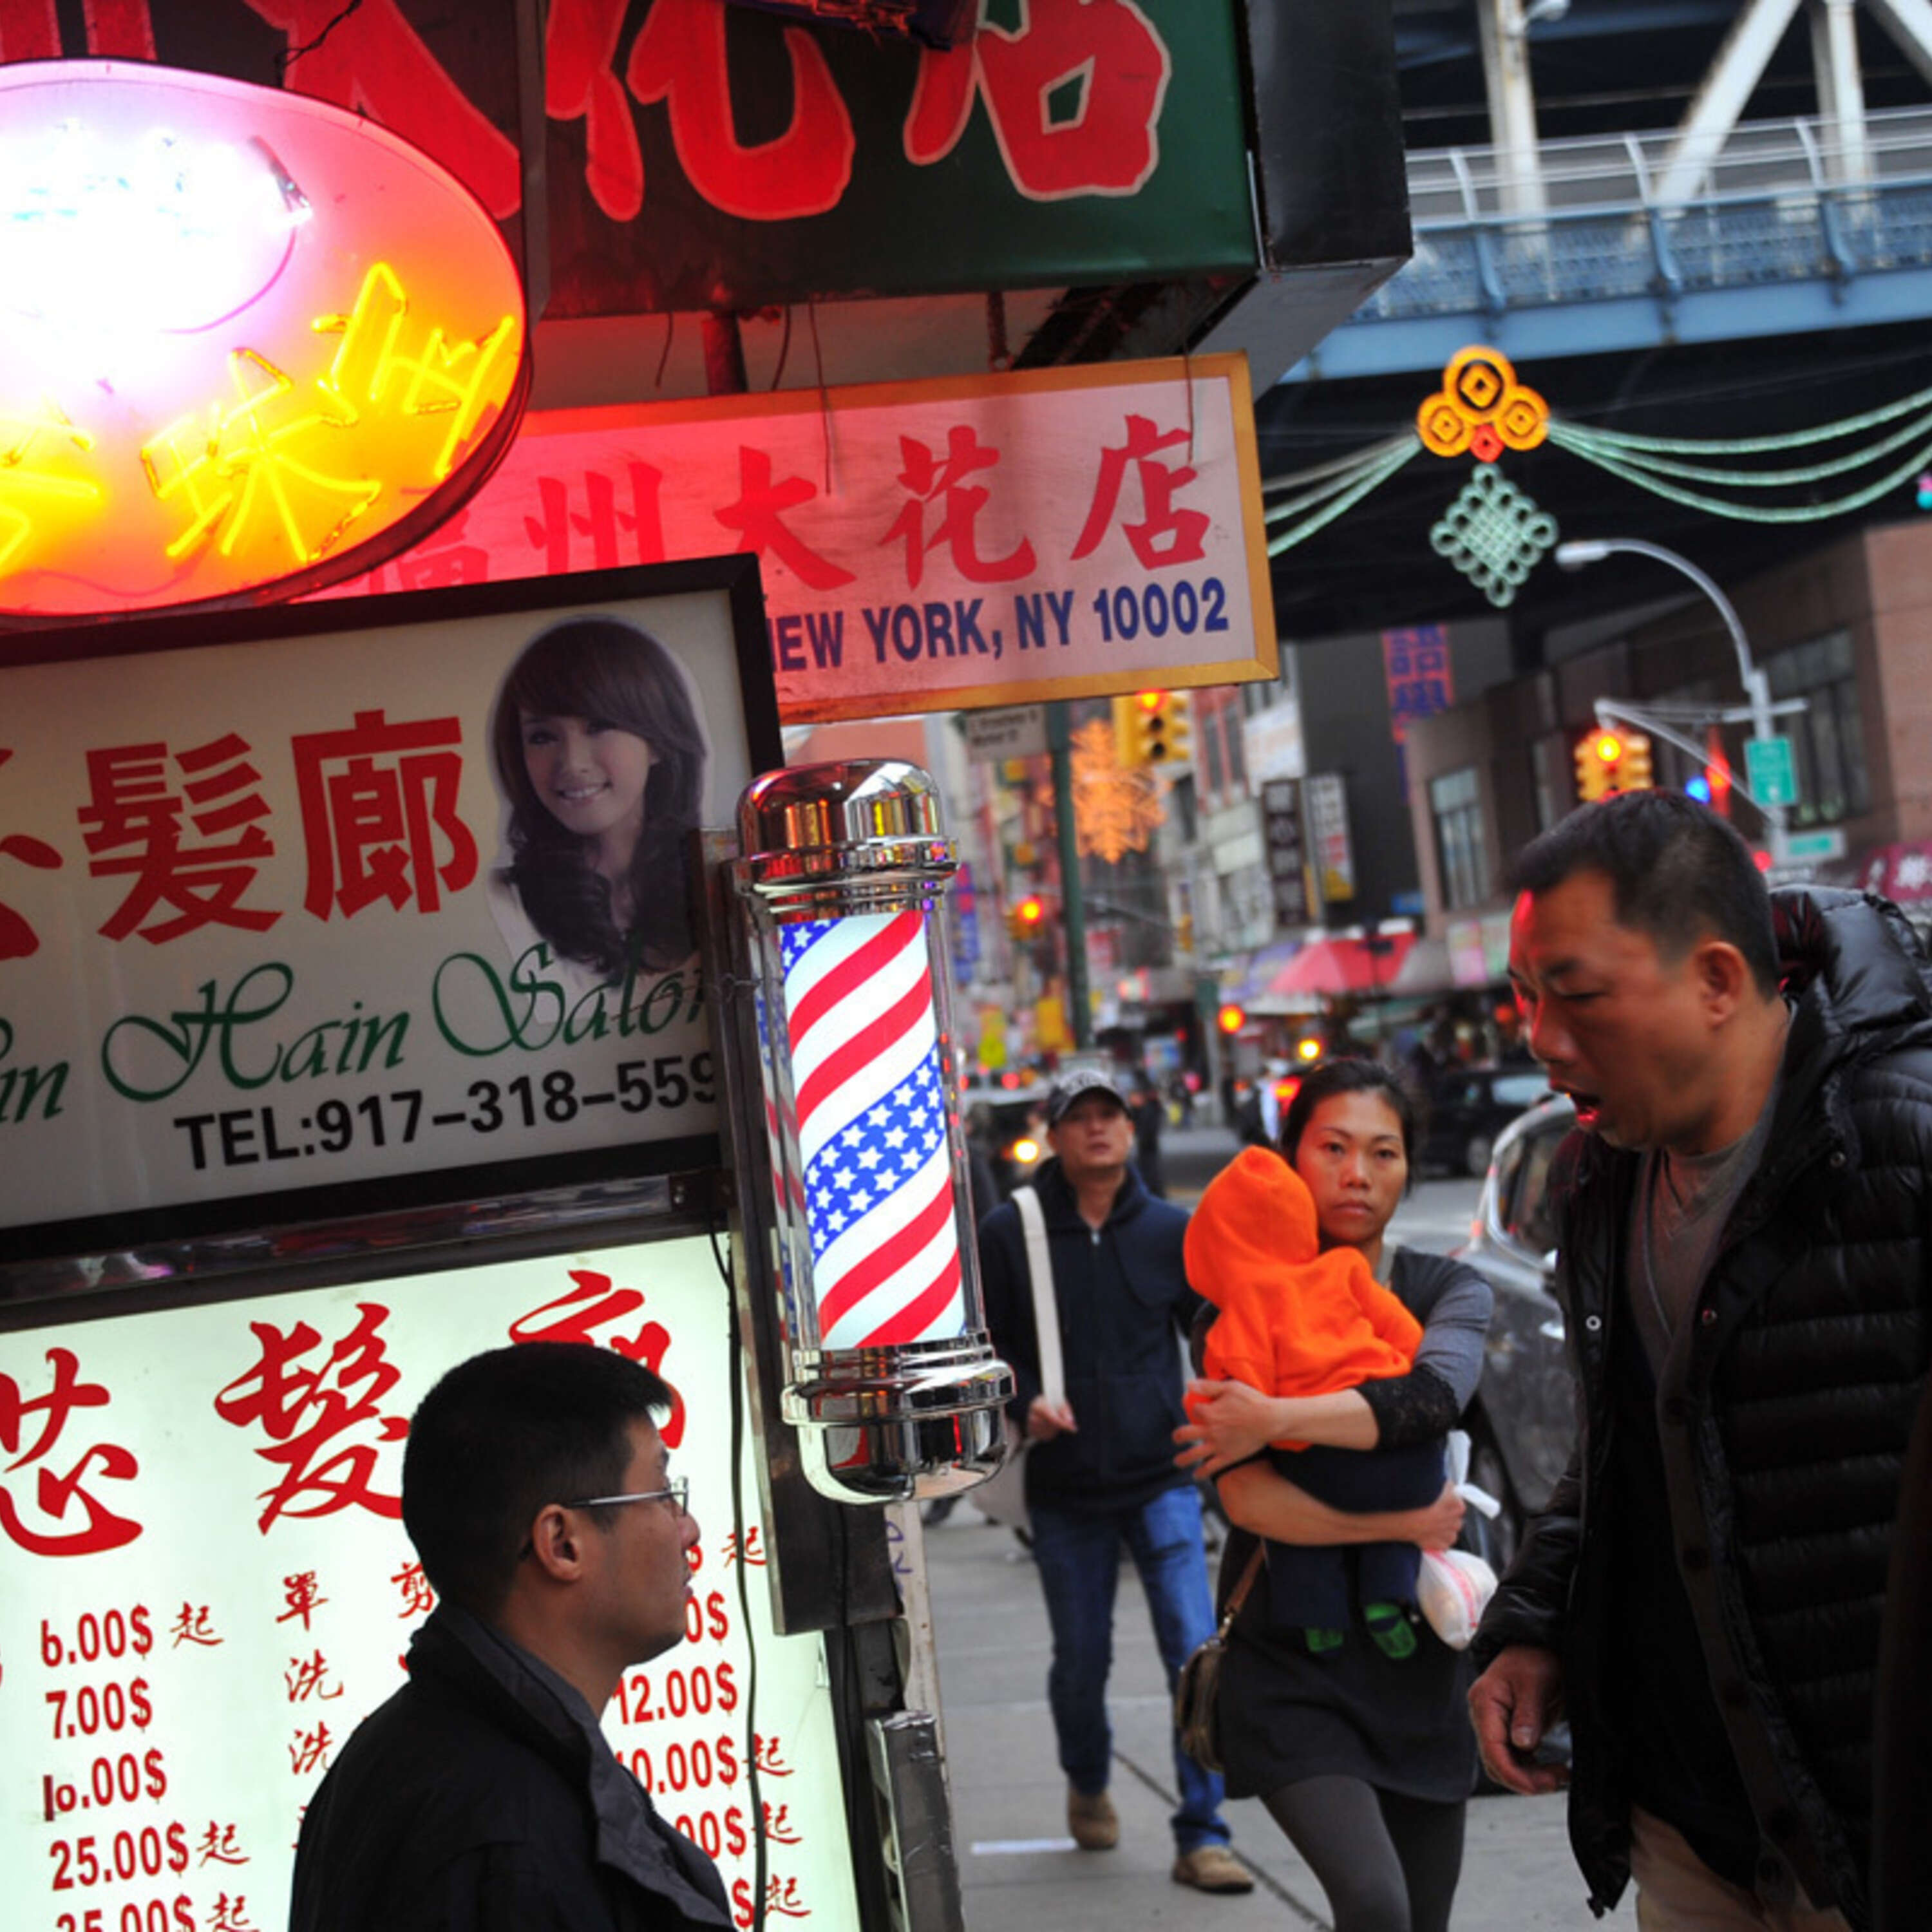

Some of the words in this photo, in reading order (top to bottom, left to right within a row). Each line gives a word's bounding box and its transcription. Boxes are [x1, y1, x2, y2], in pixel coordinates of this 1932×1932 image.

[862, 598, 1003, 665] YORK,
[1016, 591, 1075, 650] NY
[1094, 577, 1229, 642] 10002
[46, 1676, 153, 1739] 7.00$
[616, 1734, 739, 1795] 0.00$
[49, 1819, 190, 1891] 25.00$
